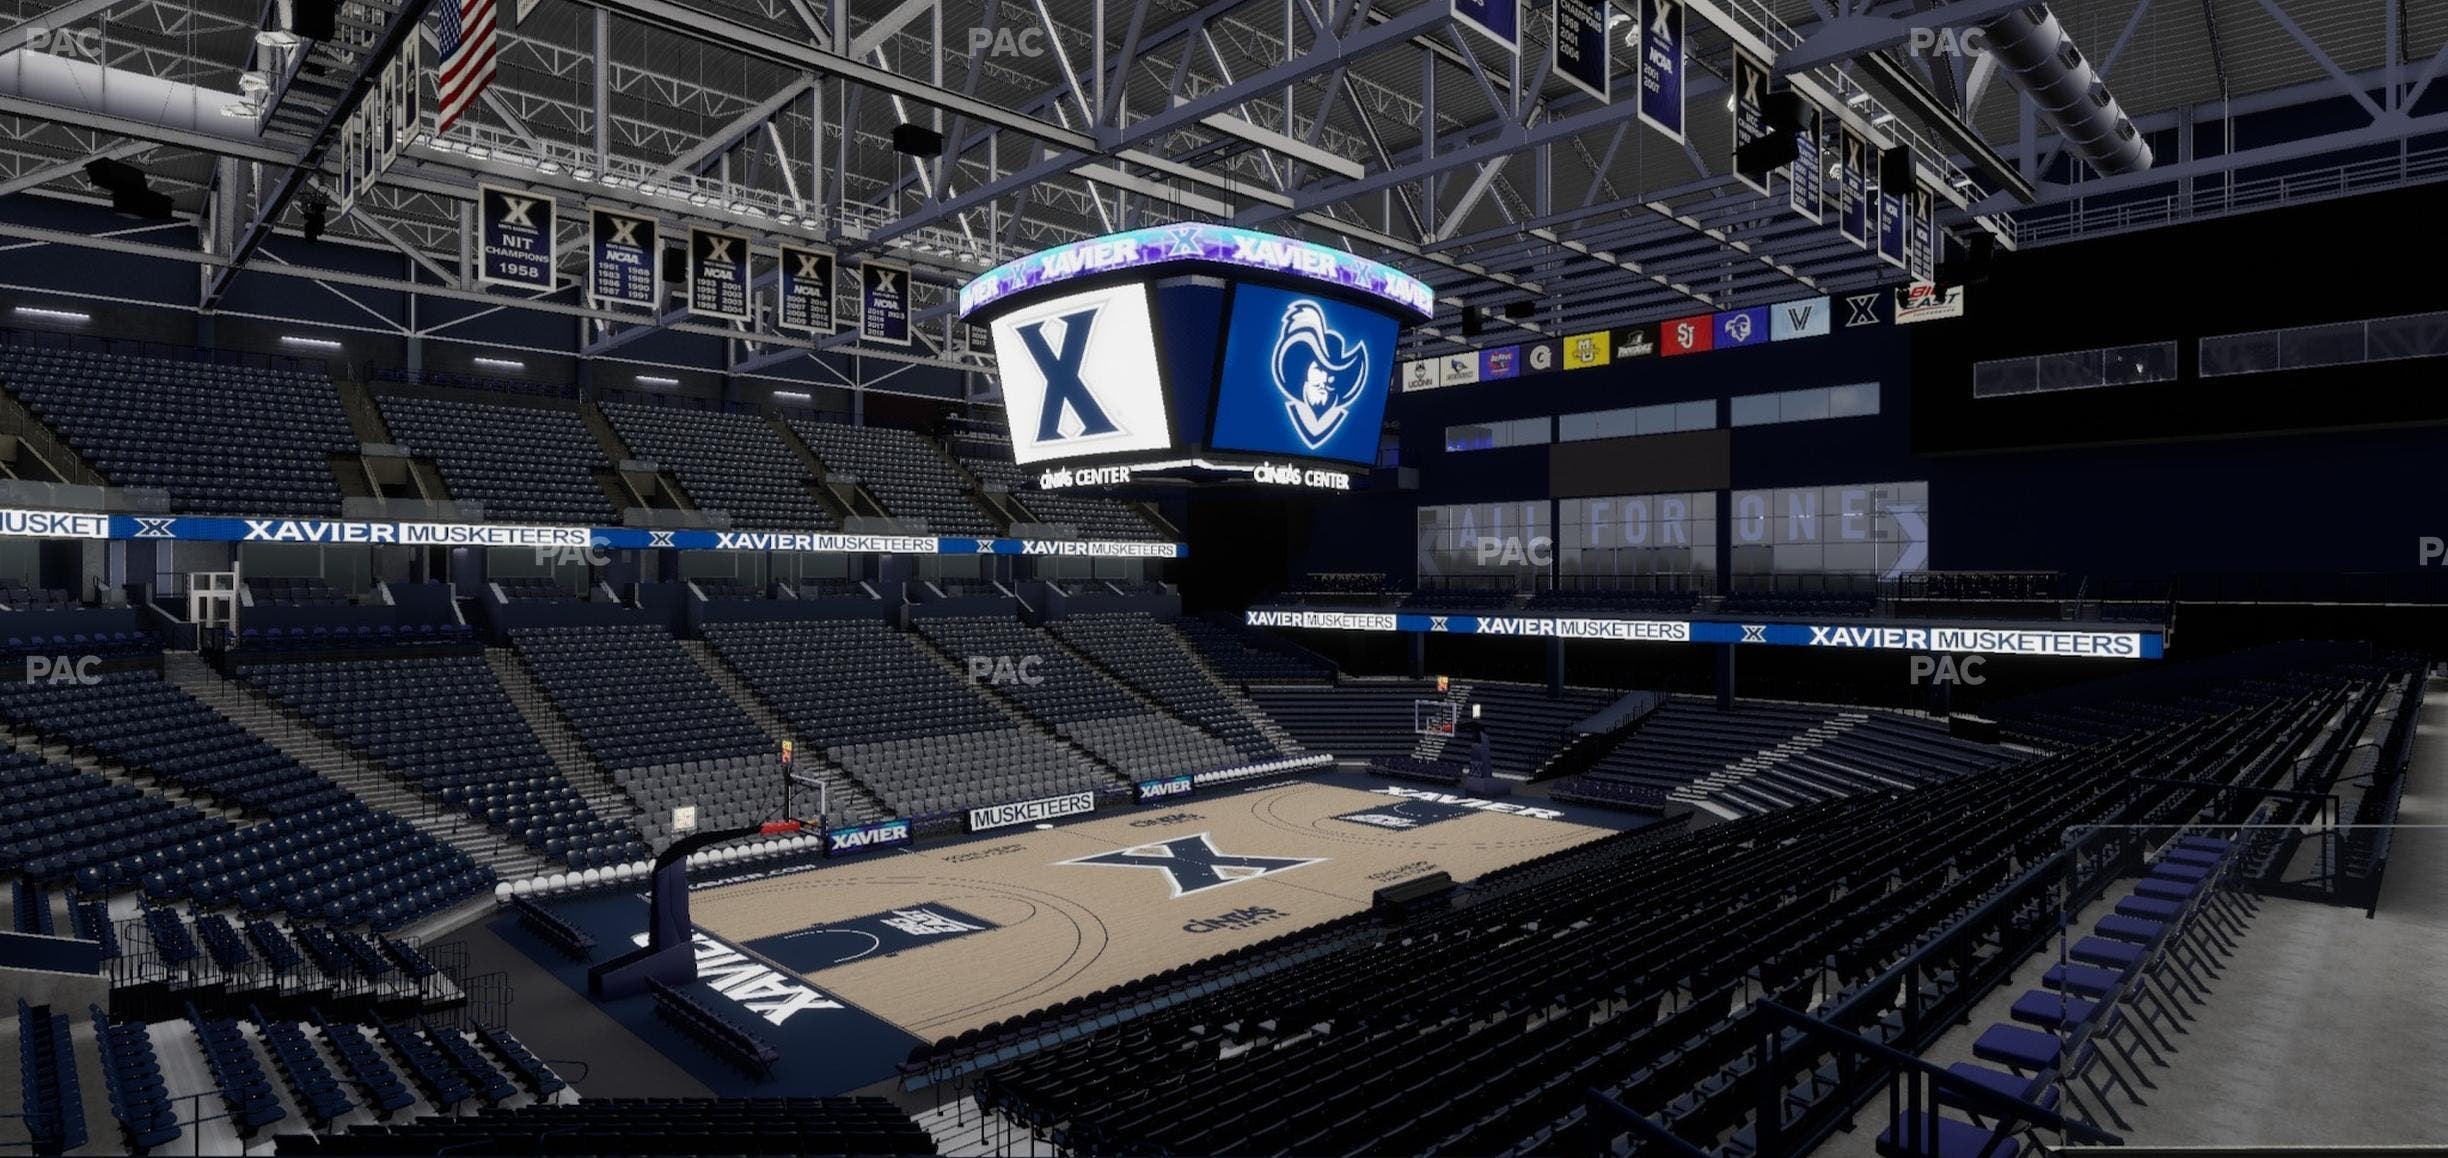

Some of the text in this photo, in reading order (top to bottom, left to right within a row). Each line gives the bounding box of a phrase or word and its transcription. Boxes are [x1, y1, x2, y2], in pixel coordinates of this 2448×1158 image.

[502, 234, 535, 250] NIT
[485, 245, 550, 263] CHAMPIONS
[606, 250, 640, 265] NCAA
[1039, 237, 1138, 282] XAVIER
[1231, 234, 1339, 279] XAVIER
[499, 262, 540, 279] 1958
[704, 267, 735, 281] NCAA
[794, 285, 822, 297] NCAA
[874, 298, 900, 311] NCAA
[1008, 300, 1130, 445] X
[1408, 377, 1433, 389] UCONN
[1075, 465, 1130, 486] CENTER
[1304, 470, 1349, 490] CENTER
[1590, 499, 1687, 546] FOR
[1741, 491, 1868, 541] ONE
[0, 511, 108, 537] USKET
[243, 518, 397, 543] XAVIER
[404, 523, 586, 542] MUSKETEERS
[715, 532, 813, 551] XAVIER
[817, 534, 934, 551] MUSKETEERS
[1021, 540, 1088, 555] XAVIER
[1090, 541, 1174, 557] MUSKETEERS
[1246, 610, 1303, 627] XAVIER
[1304, 612, 1394, 630] MUSKETEERS
[1476, 617, 1555, 636] XAVIER
[1560, 620, 1685, 639] MUSKETEERS
[1809, 625, 1930, 649] XAVIER
[1937, 630, 2131, 655] MUSKETEERS
[1140, 779, 1191, 799] XAVIER
[1367, 785, 1563, 819] XAVIER
[973, 795, 1093, 830] MUSKETEERS
[831, 824, 908, 851] XAVIER
